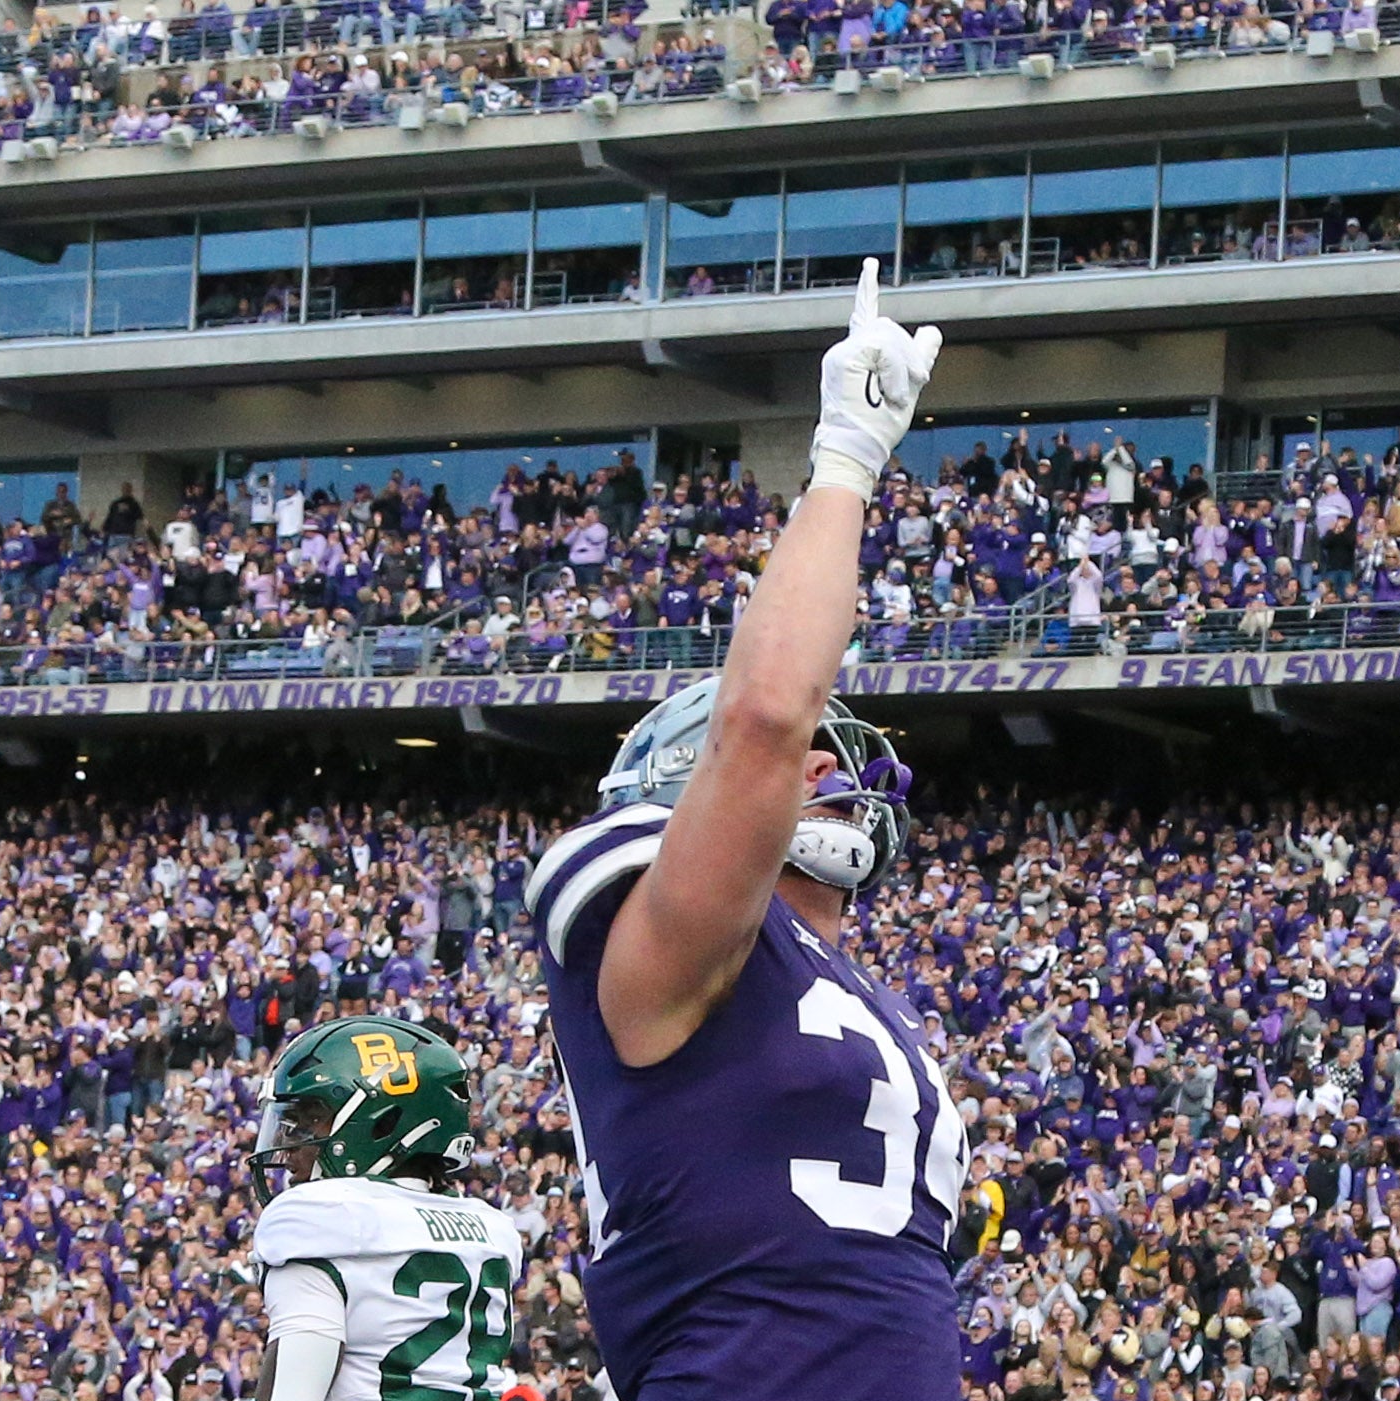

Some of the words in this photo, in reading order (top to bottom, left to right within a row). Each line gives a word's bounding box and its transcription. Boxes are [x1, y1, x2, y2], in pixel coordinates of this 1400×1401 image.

[604, 674, 656, 701] 59
[904, 660, 1072, 694] 1974-77
[1117, 658, 1149, 688] 9
[1156, 653, 1270, 686] SEAN
[179, 682, 271, 711] LYNN
[277, 681, 404, 709] DICKEY
[414, 675, 563, 707] 1968-70
[351, 1033, 420, 1095] BU
